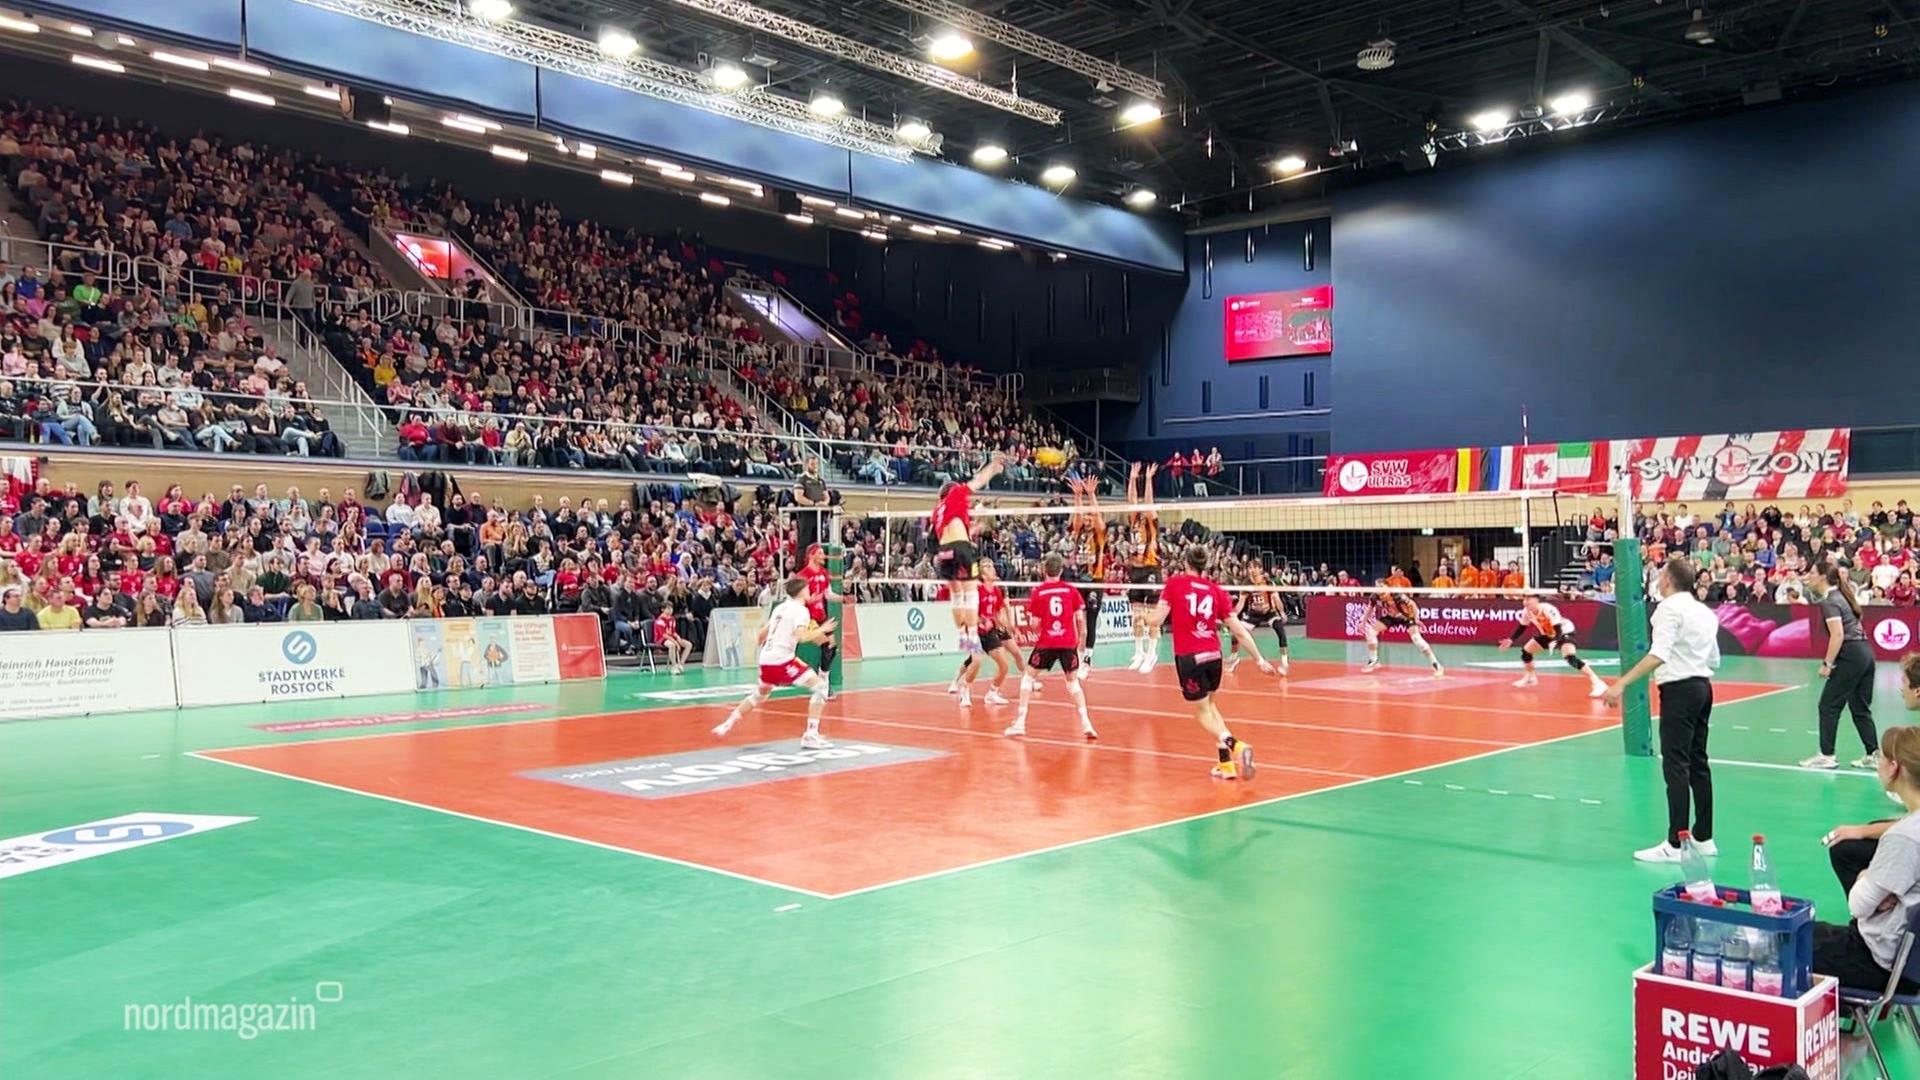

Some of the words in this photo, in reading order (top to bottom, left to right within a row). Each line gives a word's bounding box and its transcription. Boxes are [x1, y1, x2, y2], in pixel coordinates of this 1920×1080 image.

[1370, 459, 1408, 475] SVW
[1748, 449, 1843, 478] ZONE
[1049, 596, 1064, 618] 6
[1184, 592, 1214, 620] 14
[897, 633, 942, 643] STADTWERKE
[904, 642, 937, 652] ROSTOCK
[0, 660, 42, 671] einrich
[45, 656, 115, 668] Haustechnik
[68, 665, 113, 679] Günther
[258, 668, 346, 682] STADTWERKE
[271, 681, 335, 695] ROSTOCK
[1661, 1008, 1772, 1058] REWE
[1805, 1010, 1835, 1061] REWE
